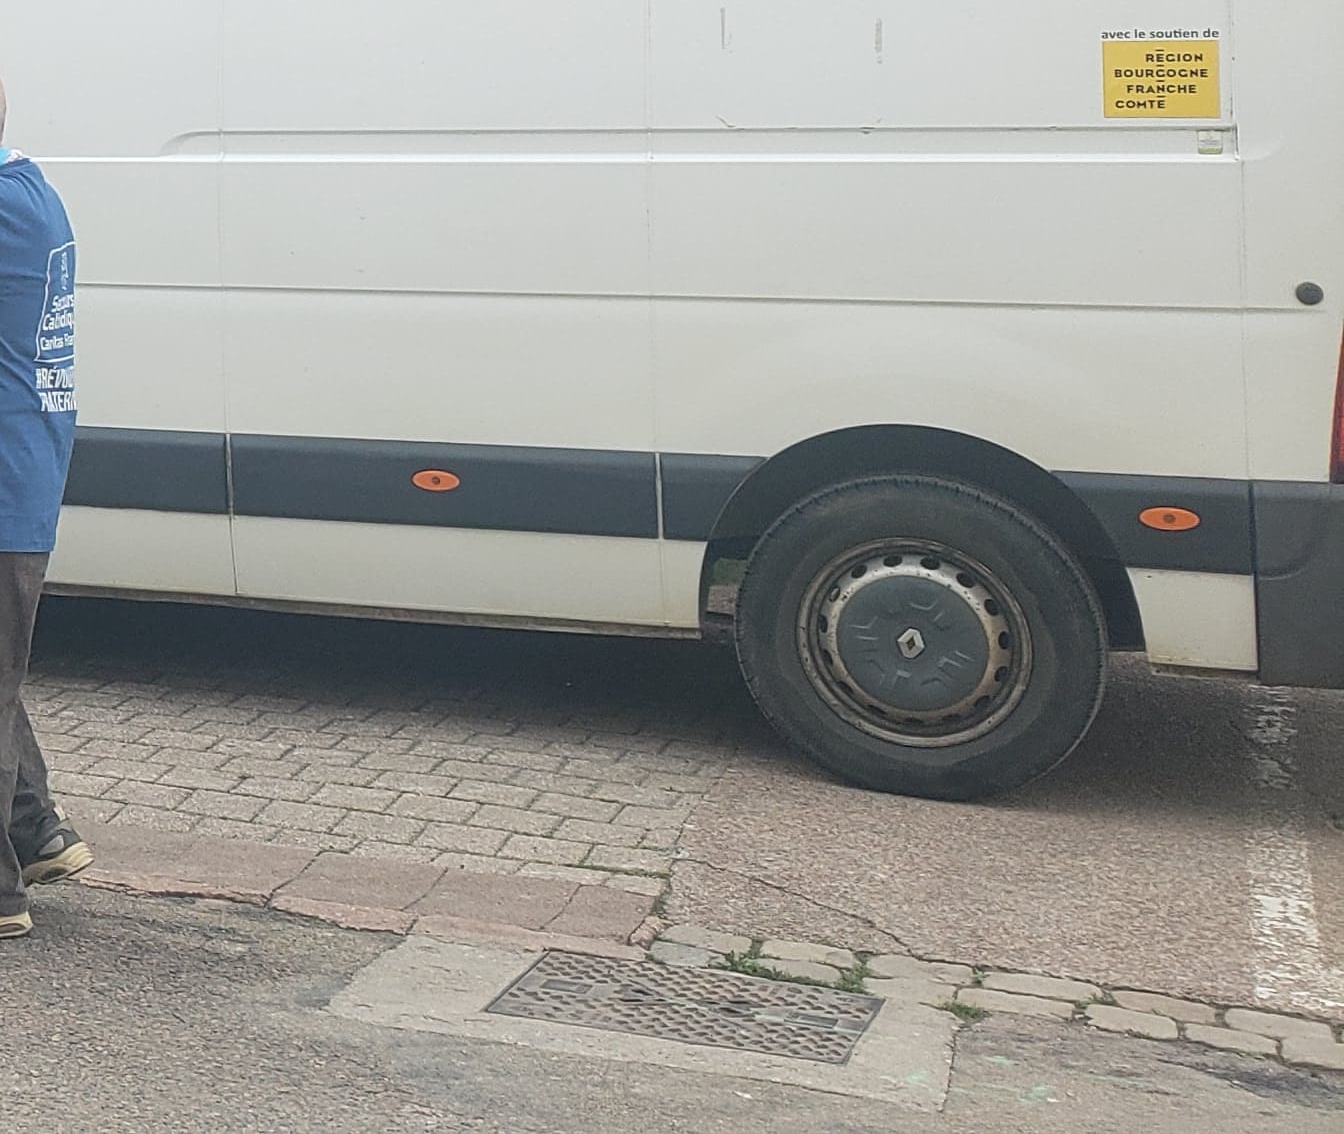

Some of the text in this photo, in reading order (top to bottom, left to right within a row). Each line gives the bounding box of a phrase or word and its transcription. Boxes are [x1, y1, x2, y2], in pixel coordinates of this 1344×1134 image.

[1101, 28, 1220, 39] avec le soutien de
[1114, 69, 1209, 78] BOURGOGNE
[1127, 84, 1197, 94] FRANCHE
